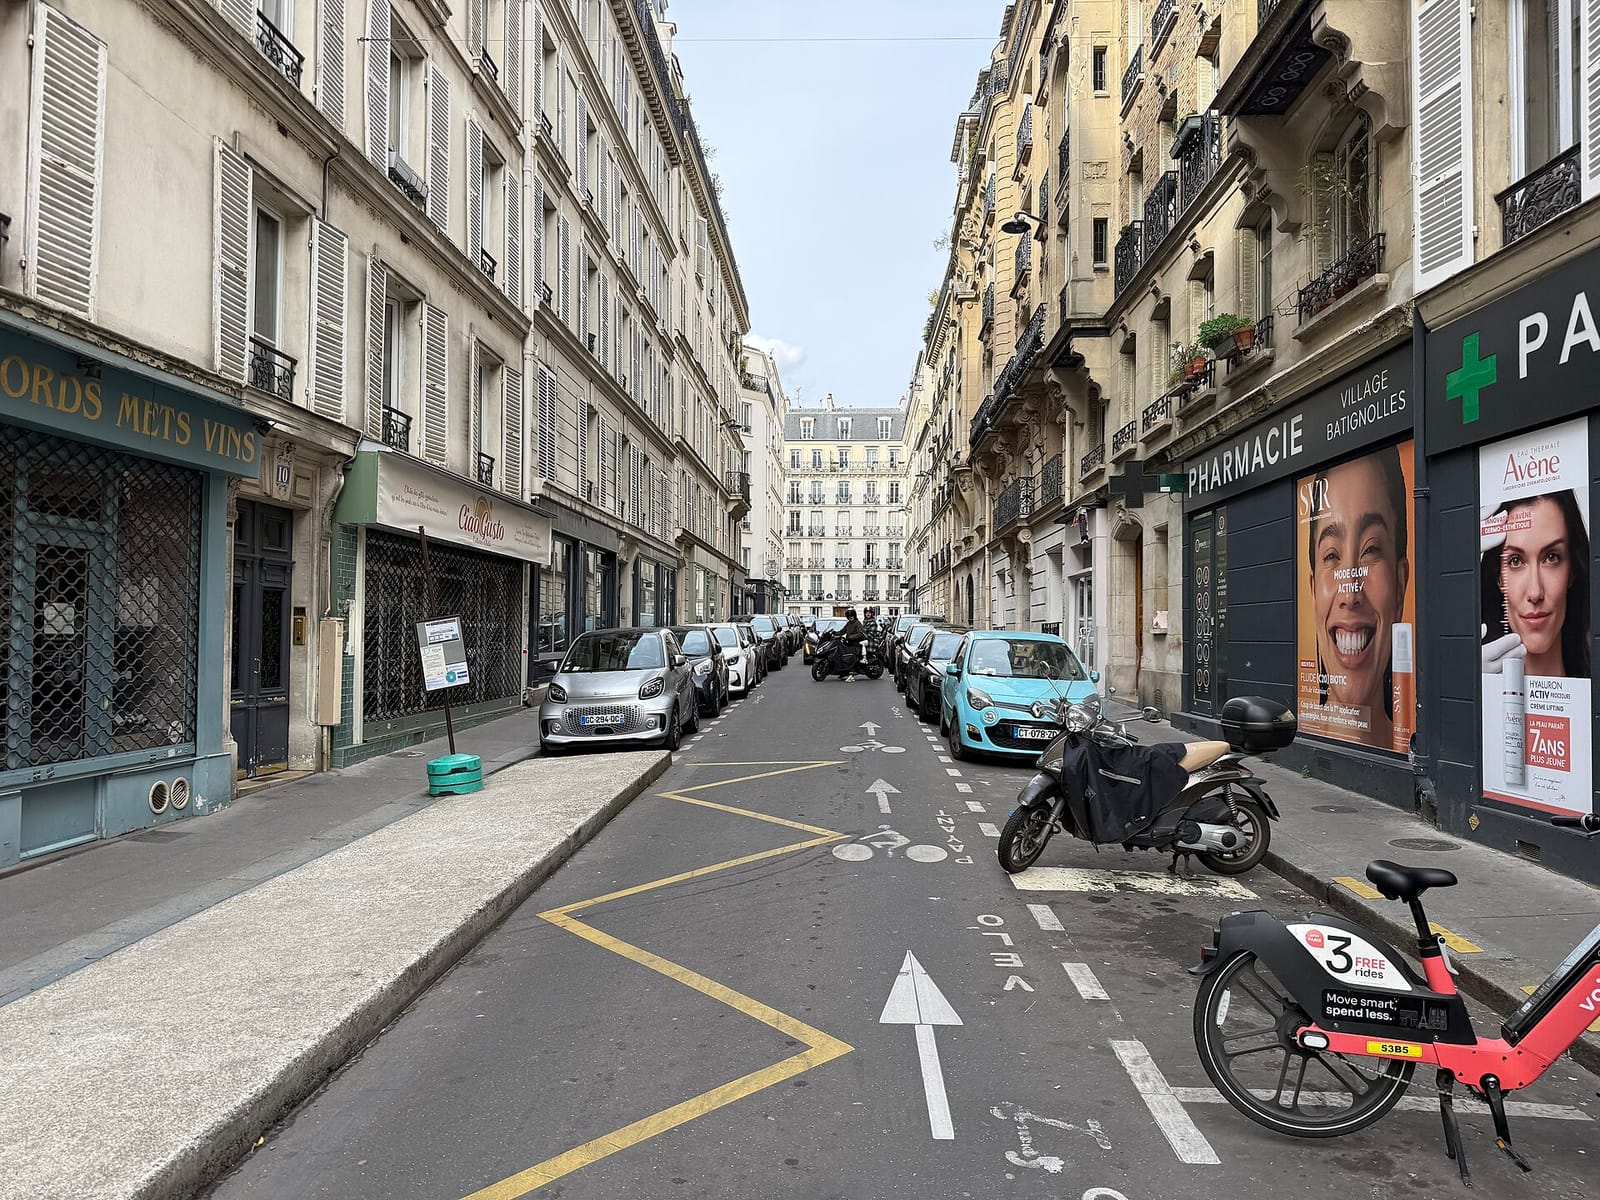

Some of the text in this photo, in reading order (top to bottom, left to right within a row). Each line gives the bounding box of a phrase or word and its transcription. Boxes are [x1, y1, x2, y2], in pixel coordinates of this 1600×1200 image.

[1519, 291, 1600, 380] PA
[1340, 369, 1389, 409] VILLAGE
[1, 355, 256, 463] ORDS METS VINS
[1326, 390, 1407, 441] BATIGNOLLES
[1188, 413, 1304, 498] PHARMACIE
[1517, 440, 1561, 458] EAU THERMALE
[277, 466, 288, 484] 10
[1503, 453, 1561, 484] Avène
[1299, 478, 1332, 516] SVR
[458, 503, 480, 534] Ciao
[478, 511, 505, 541] Gusto
[1334, 566, 1369, 580] MODE GLOW
[1300, 672, 1317, 683] FLUIDE
[1529, 680, 1563, 690] HYALURON
[1529, 690, 1550, 700] ACTIV
[1529, 720, 1536, 728] LA
[1536, 721, 1547, 729] PEAU
[1530, 754, 1567, 768] PLUS JEUNE
[1325, 934, 1386, 974] 3 FREE
[1354, 967, 1384, 979] rides
[1325, 992, 1358, 1006] Move
[1325, 1005, 1393, 1021] spend less.
[1380, 1044, 1409, 1055] 53B5
